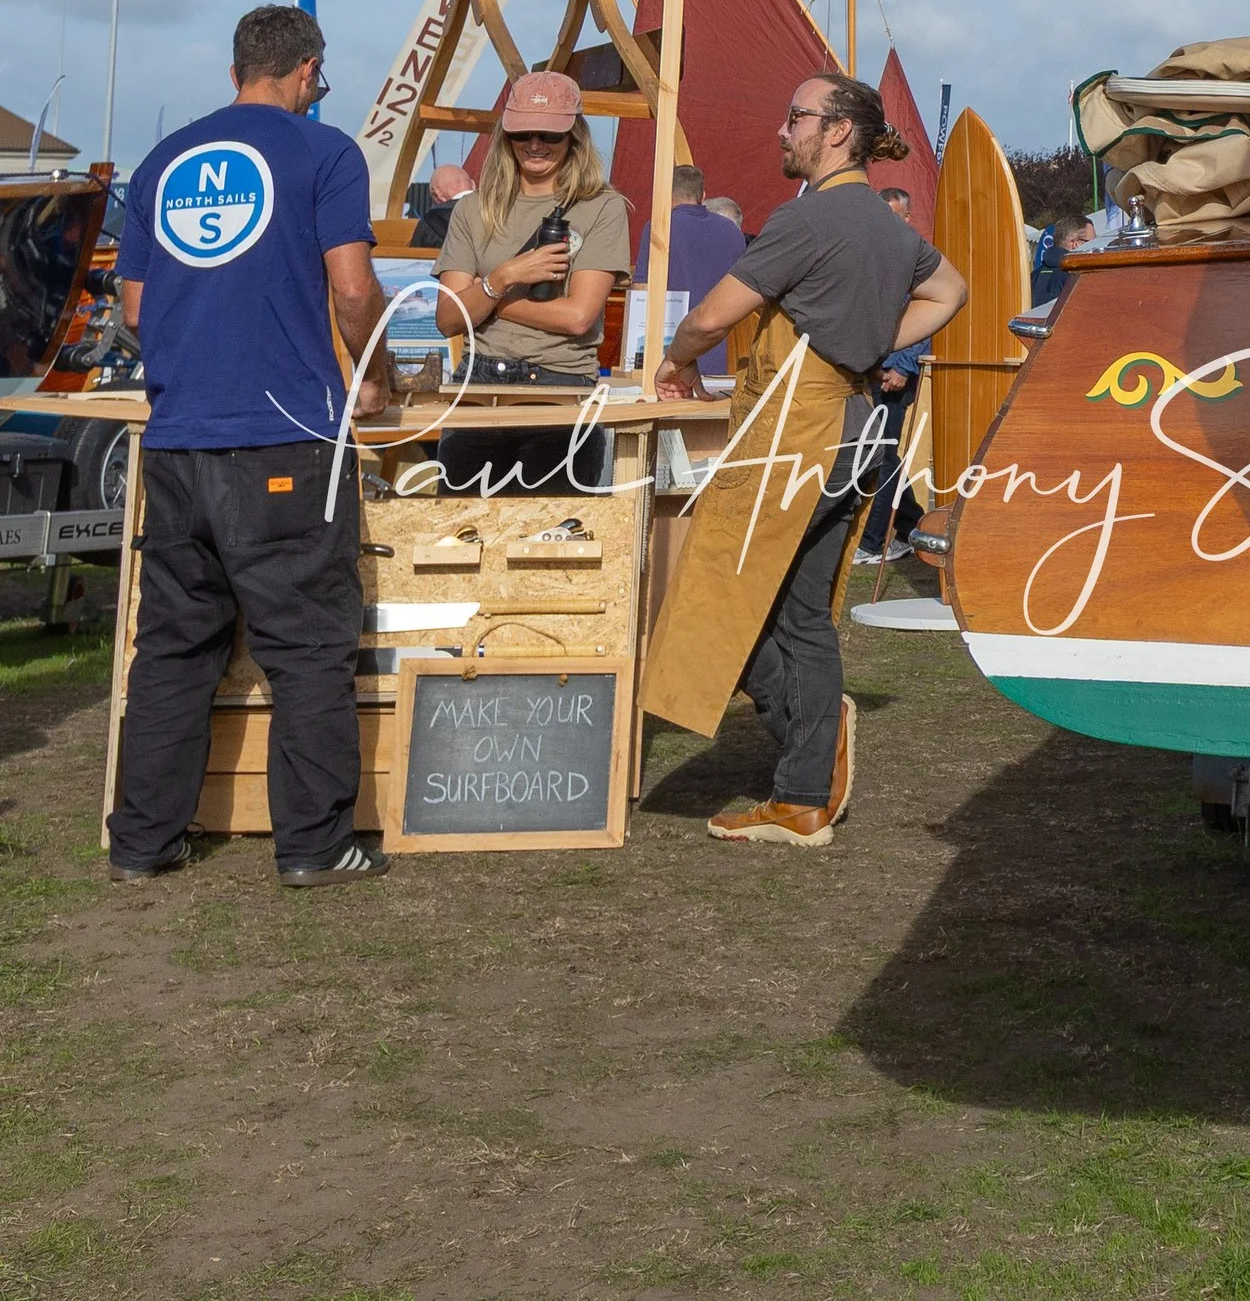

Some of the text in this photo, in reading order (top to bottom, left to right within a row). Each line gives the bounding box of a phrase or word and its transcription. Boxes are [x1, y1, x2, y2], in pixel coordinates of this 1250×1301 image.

[198, 161, 228, 193] N
[166, 192, 256, 209] NORTH SAILS
[199, 212, 222, 245] S
[430, 694, 594, 729] MAKE YOUR
[474, 734, 542, 763] OWN
[423, 770, 590, 804] SURFBOARD
